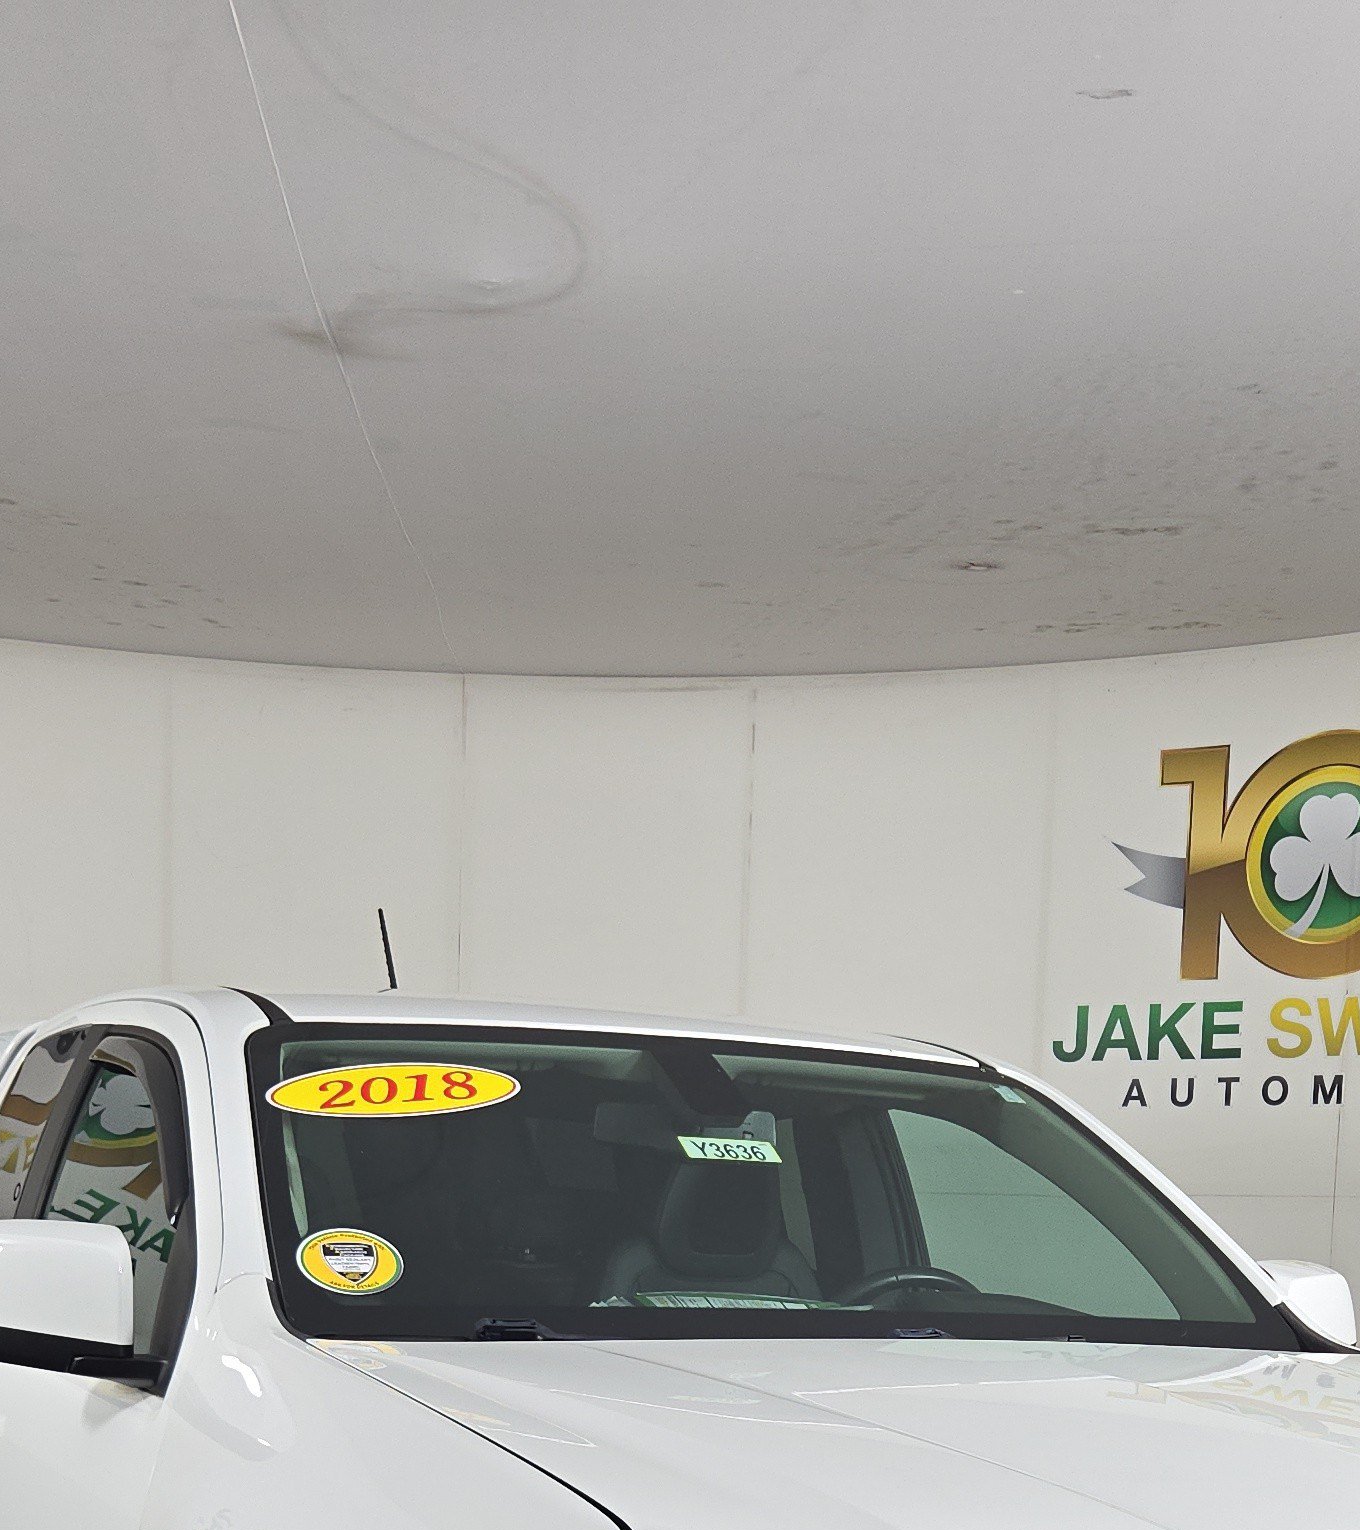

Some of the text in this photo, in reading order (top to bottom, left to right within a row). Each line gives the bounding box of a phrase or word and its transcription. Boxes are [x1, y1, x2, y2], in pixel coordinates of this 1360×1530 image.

[1052, 1001, 1243, 1063] JAKE
[319, 1071, 478, 1110] 2018
[689, 1140, 767, 1161] Y3636
